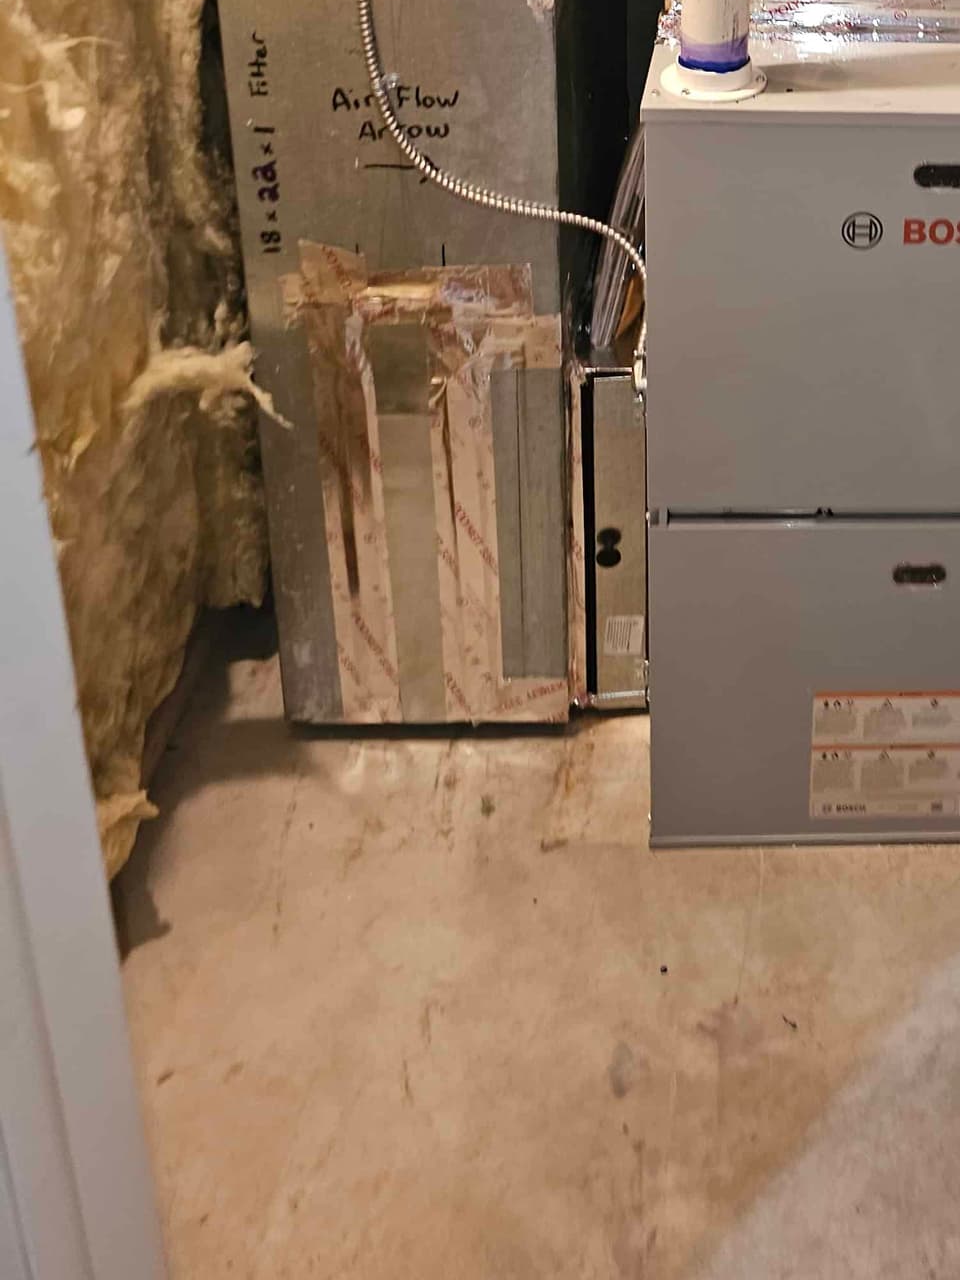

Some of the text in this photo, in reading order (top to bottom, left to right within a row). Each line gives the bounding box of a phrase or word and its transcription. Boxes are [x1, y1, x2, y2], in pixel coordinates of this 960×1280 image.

[248, 32, 269, 96] Filter
[332, 86, 459, 111] Air Flow
